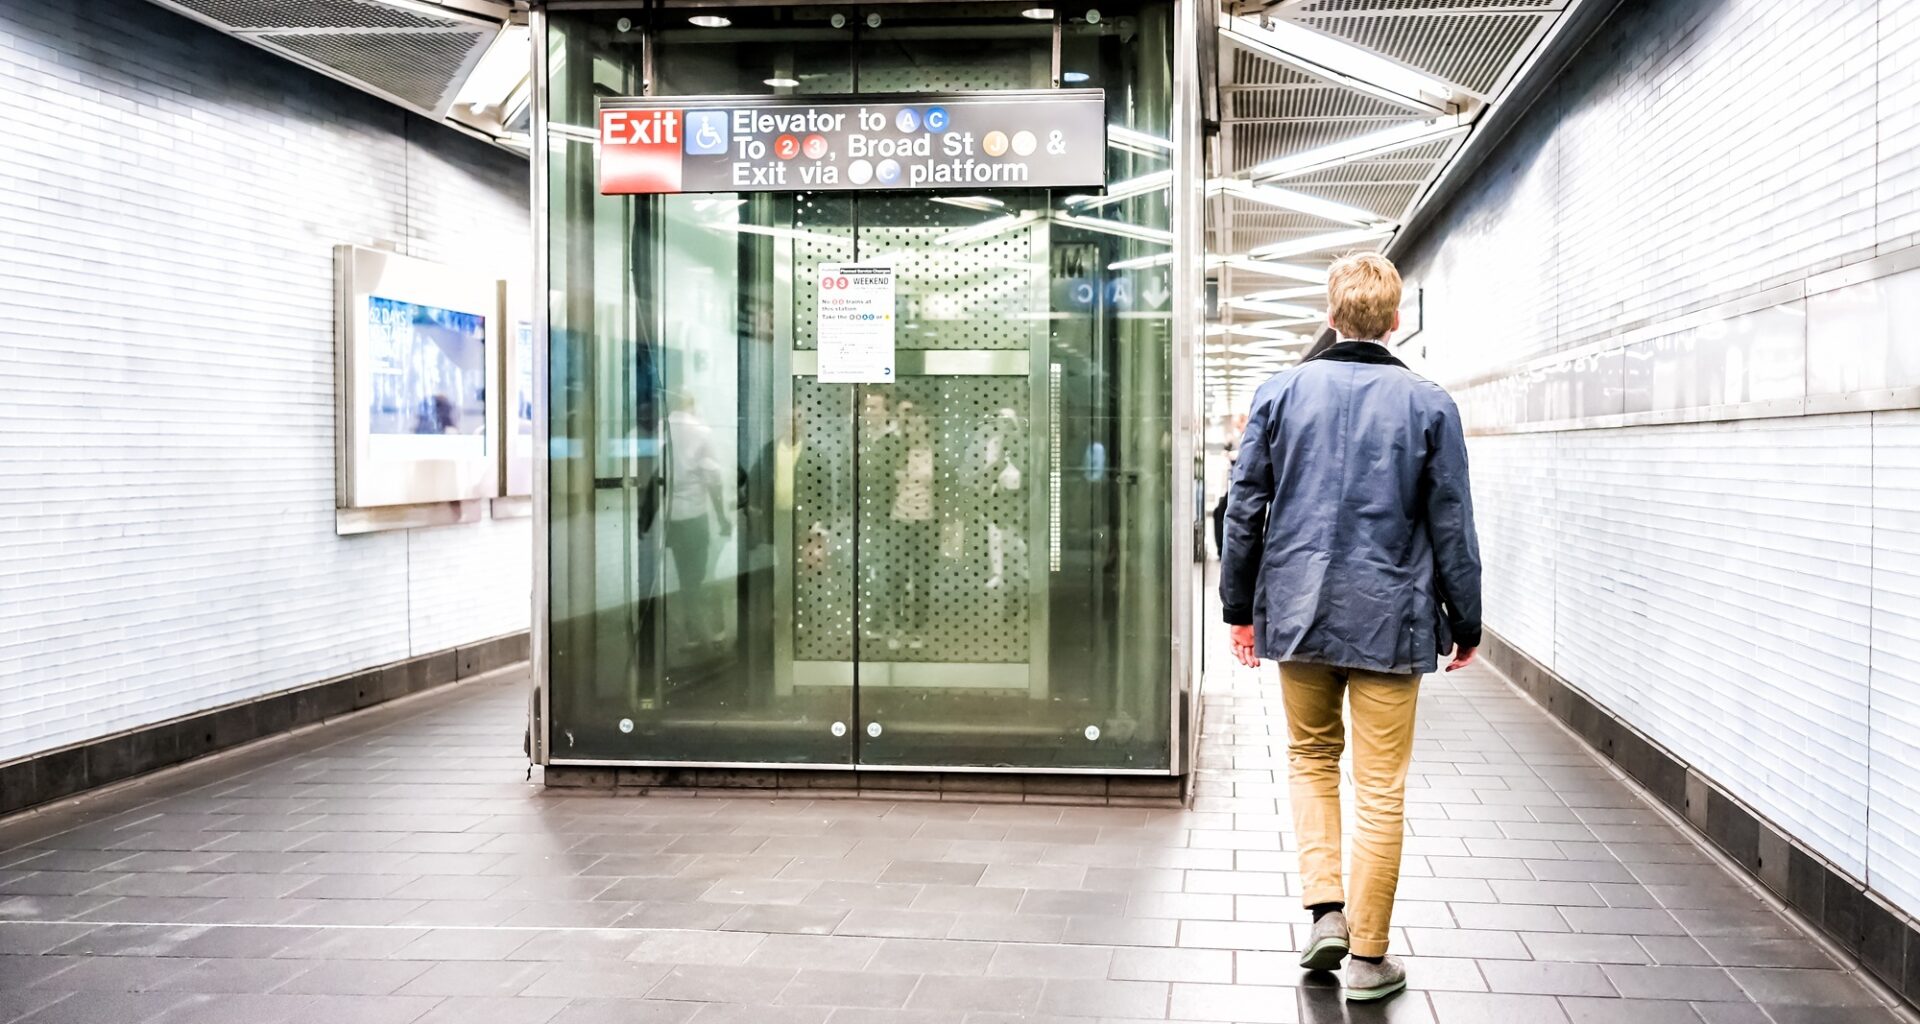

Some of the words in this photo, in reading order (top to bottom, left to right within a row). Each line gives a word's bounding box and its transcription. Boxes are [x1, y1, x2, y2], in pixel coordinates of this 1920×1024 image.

[602, 110, 678, 145] Exit
[732, 109, 845, 133] Elevator
[858, 107, 886, 131] to
[902, 112, 915, 127] A
[929, 111, 943, 128] C
[733, 135, 766, 159] To
[781, 139, 793, 155] 2
[848, 132, 931, 157] Broad
[943, 131, 974, 156] St
[1046, 129, 1067, 155] &
[733, 161, 787, 186] Exit
[799, 161, 839, 184] via
[910, 158, 1028, 188] platform
[853, 277, 889, 285] WEEKEND
